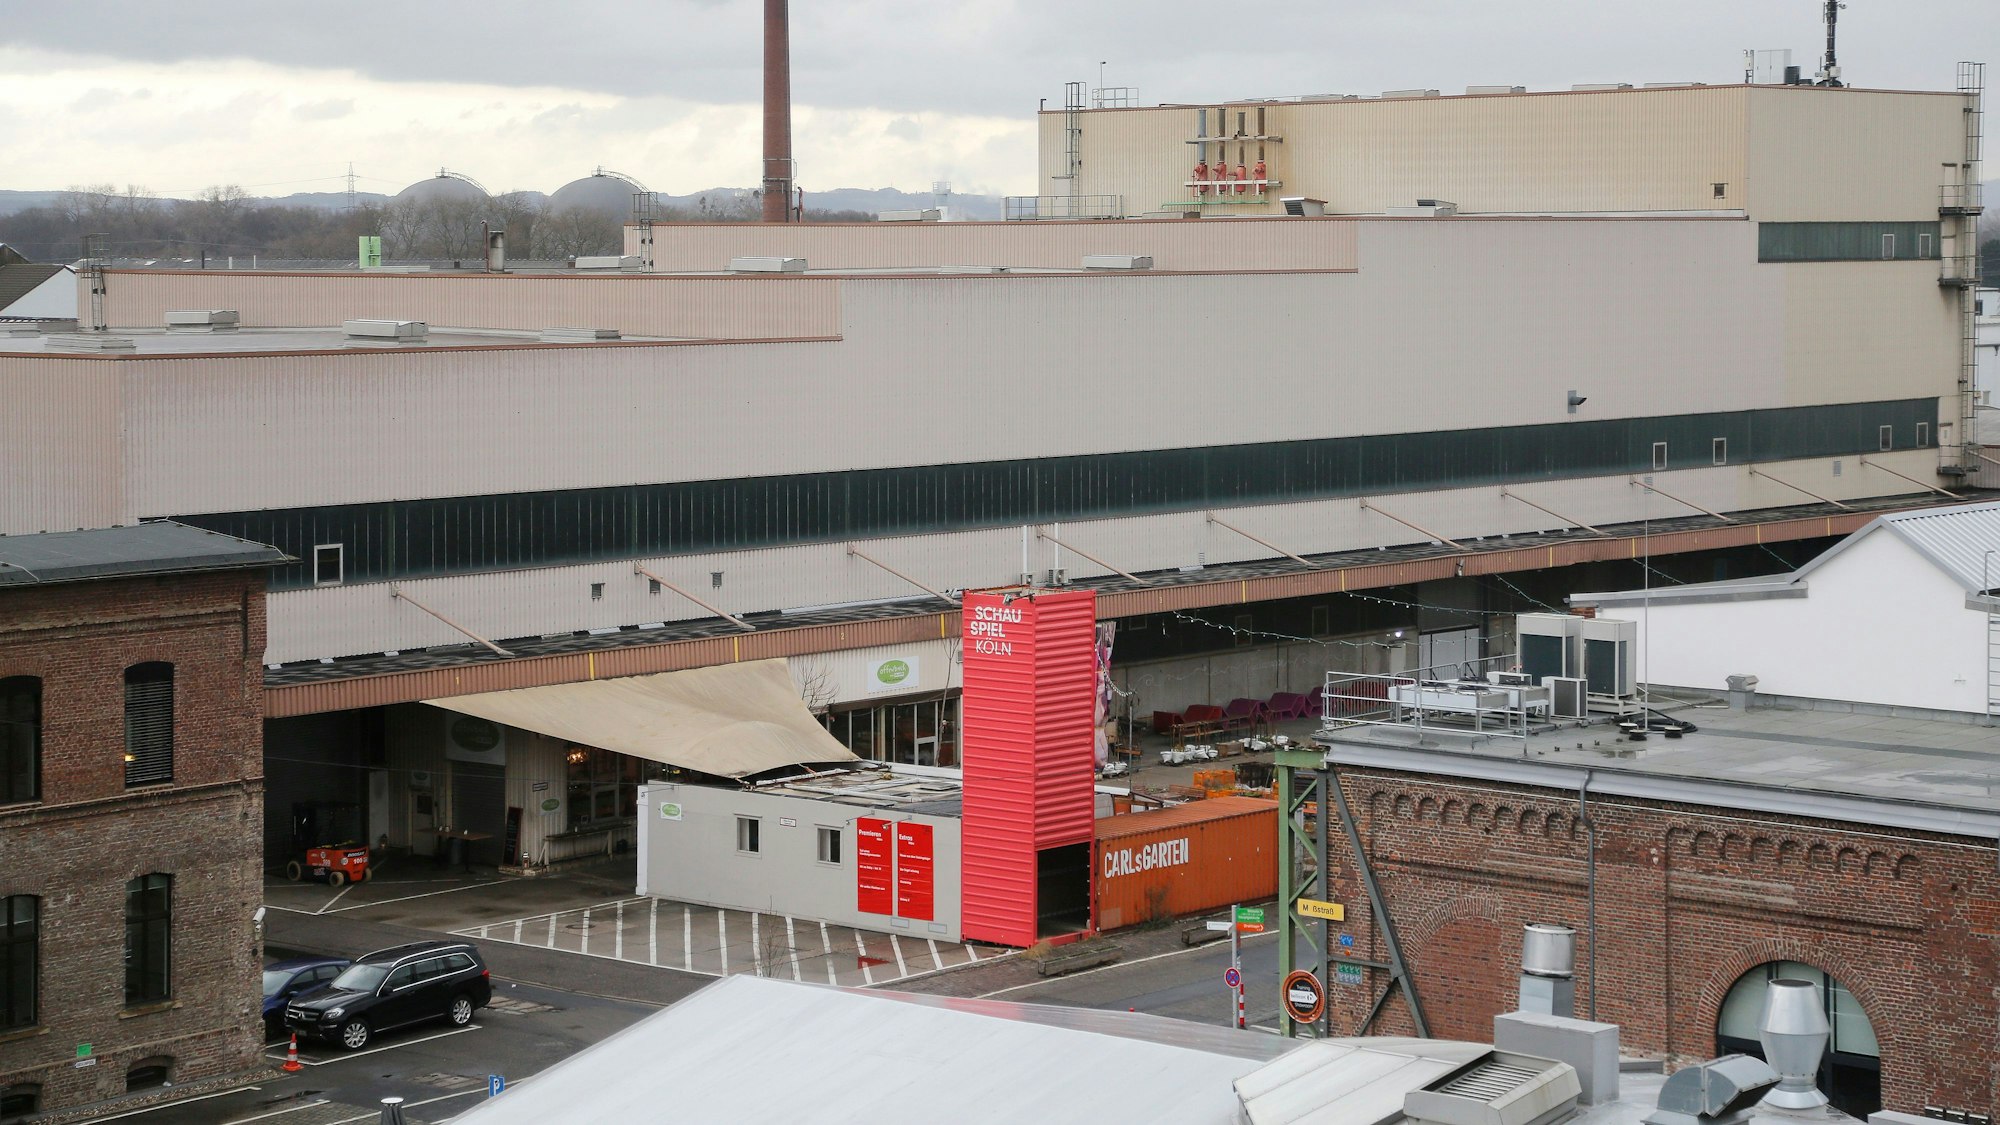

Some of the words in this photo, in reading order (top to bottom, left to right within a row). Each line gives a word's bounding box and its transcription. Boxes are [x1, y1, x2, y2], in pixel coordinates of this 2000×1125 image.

[975, 605, 1022, 623] SCHAU
[840, 632, 845, 640] 2
[970, 621, 1005, 638] SPIEL
[975, 638, 1011, 656] KÖLN
[455, 676, 459, 685] 1
[858, 829, 882, 838] Premieren
[898, 833, 913, 841] Extras
[1104, 838, 1188, 878] CARLsGARTEN
